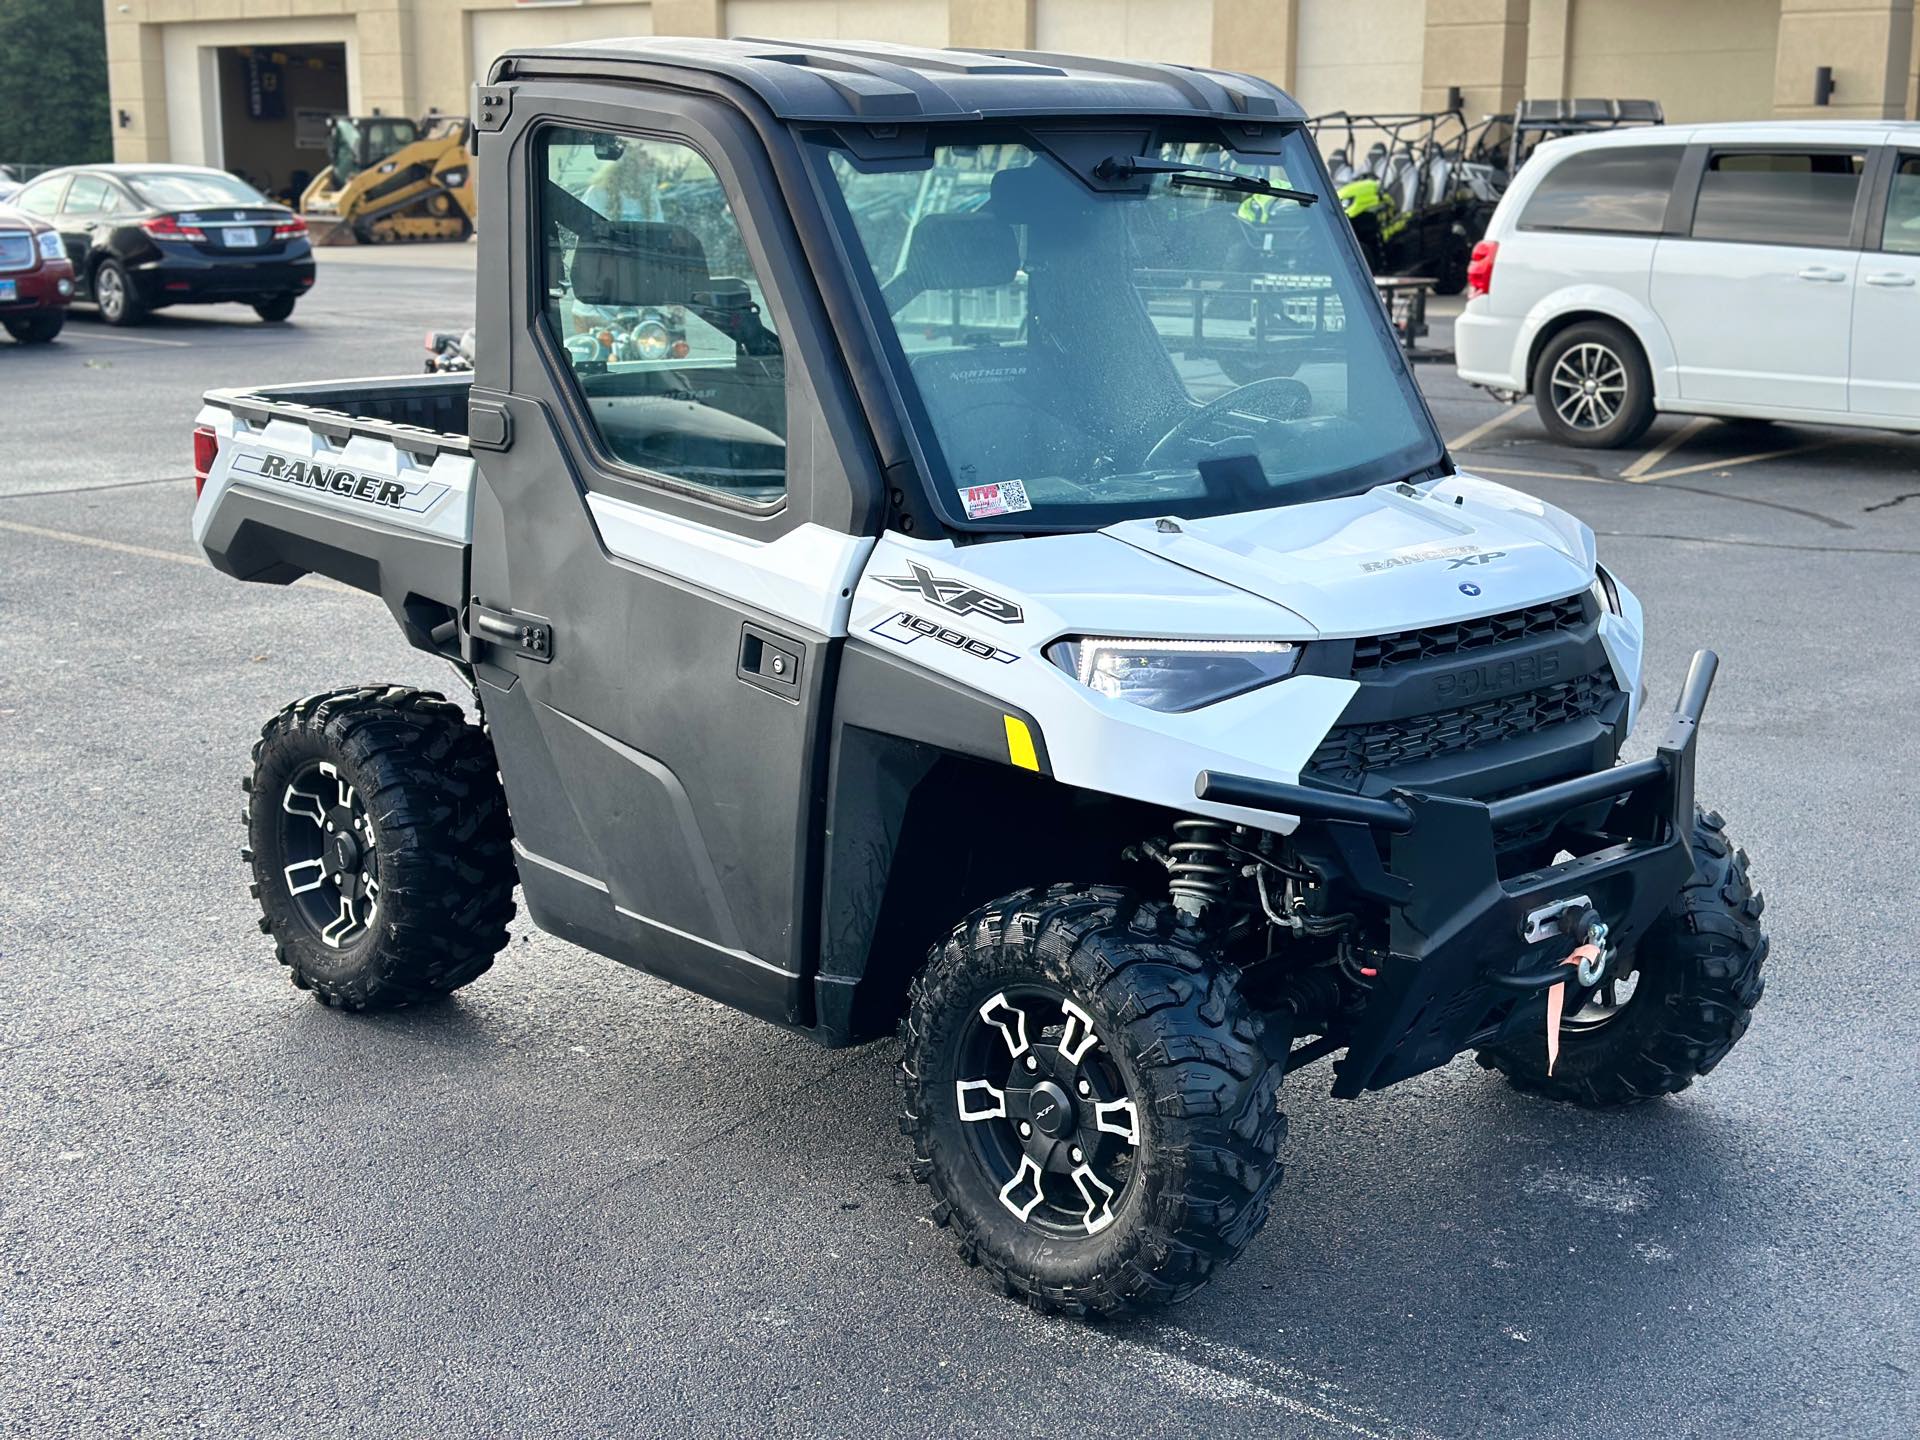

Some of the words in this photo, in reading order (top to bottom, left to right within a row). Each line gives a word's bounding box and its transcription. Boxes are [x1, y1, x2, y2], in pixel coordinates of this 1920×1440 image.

[260, 452, 407, 509] RANGER
[1360, 545, 1482, 573] RANGER
[1447, 551, 1507, 571] XP
[868, 558, 1025, 625] XP
[898, 610, 998, 660] 1000
[1431, 650, 1560, 699] POLARIS
[1035, 1104, 1055, 1120] XP
